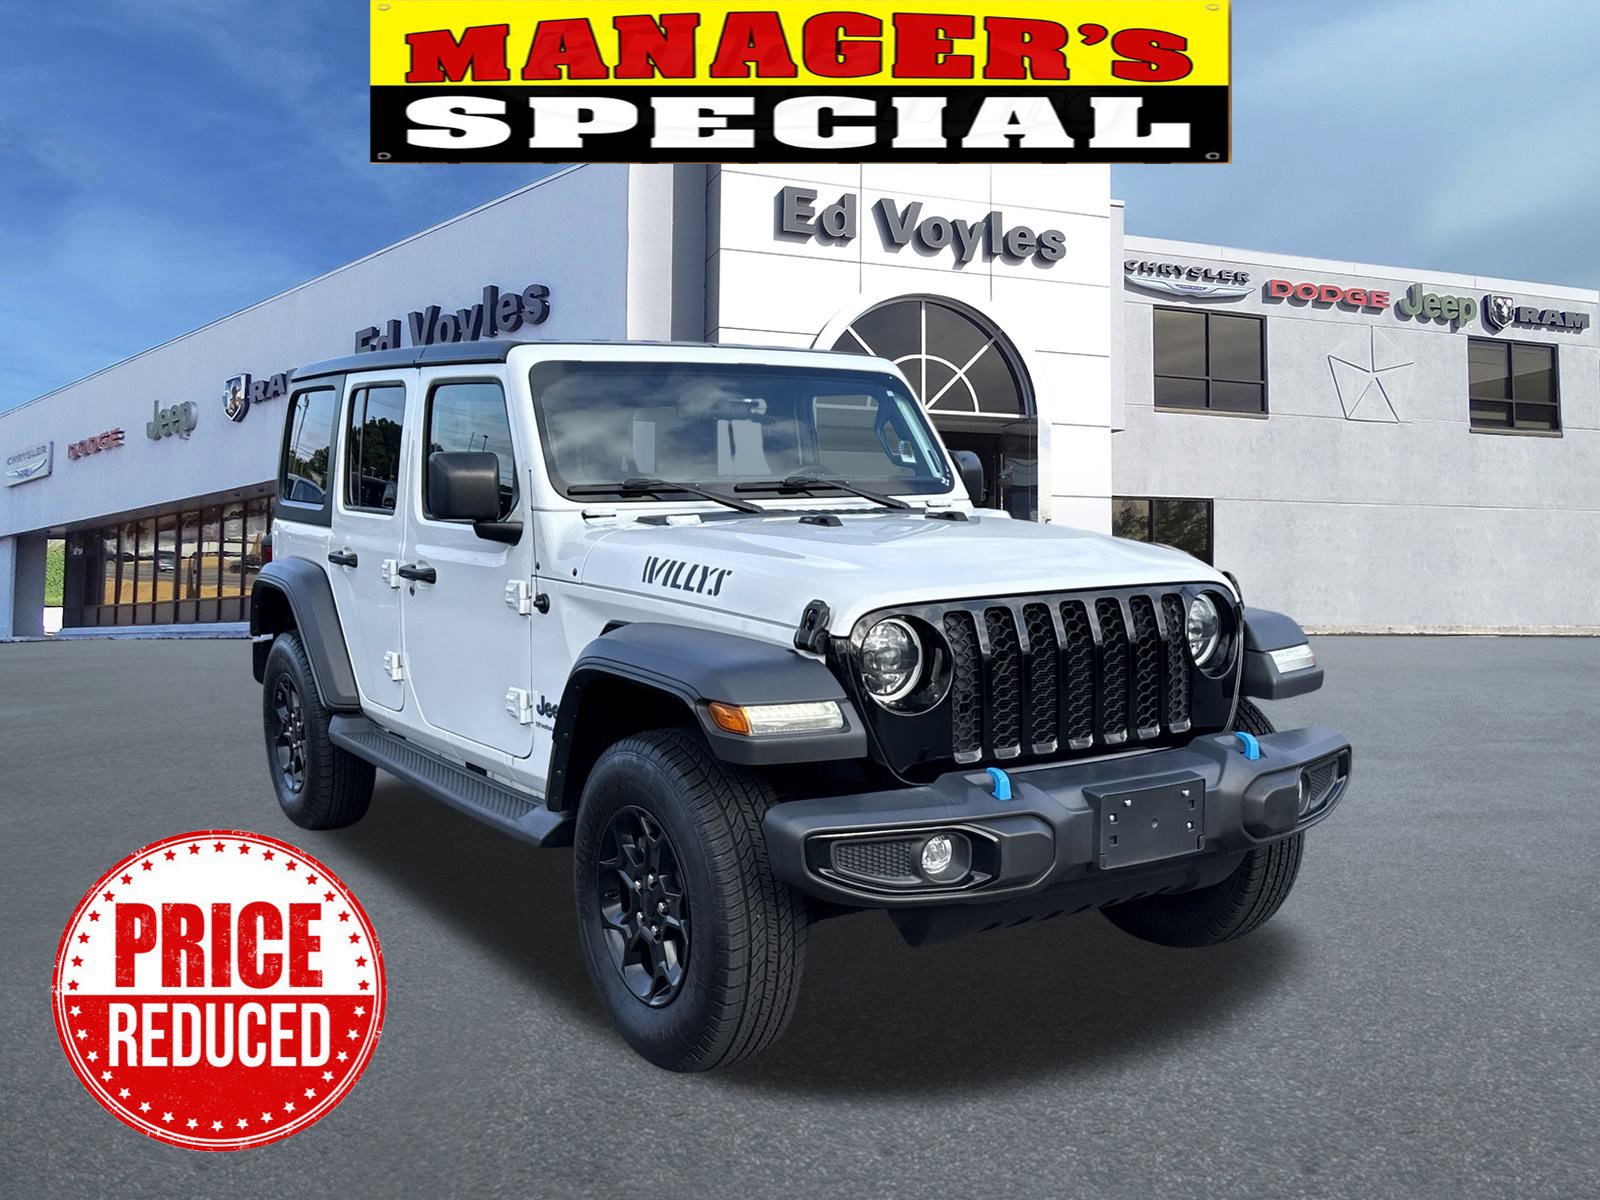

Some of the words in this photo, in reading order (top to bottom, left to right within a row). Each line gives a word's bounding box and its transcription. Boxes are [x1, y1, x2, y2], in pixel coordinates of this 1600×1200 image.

[775, 186, 857, 245] Ed
[871, 198, 1066, 264] Voyles
[1124, 260, 1250, 286] CHRYSLER
[1266, 279, 1390, 312] DODGE
[1396, 283, 1477, 331] Jeep
[408, 284, 550, 346] Voyles
[1516, 306, 1590, 333] RAM
[250, 368, 298, 403] RA
[146, 400, 199, 441] Jeep
[67, 427, 125, 460] DODGE
[642, 556, 733, 596] WILLYS
[536, 694, 559, 719] Jee
